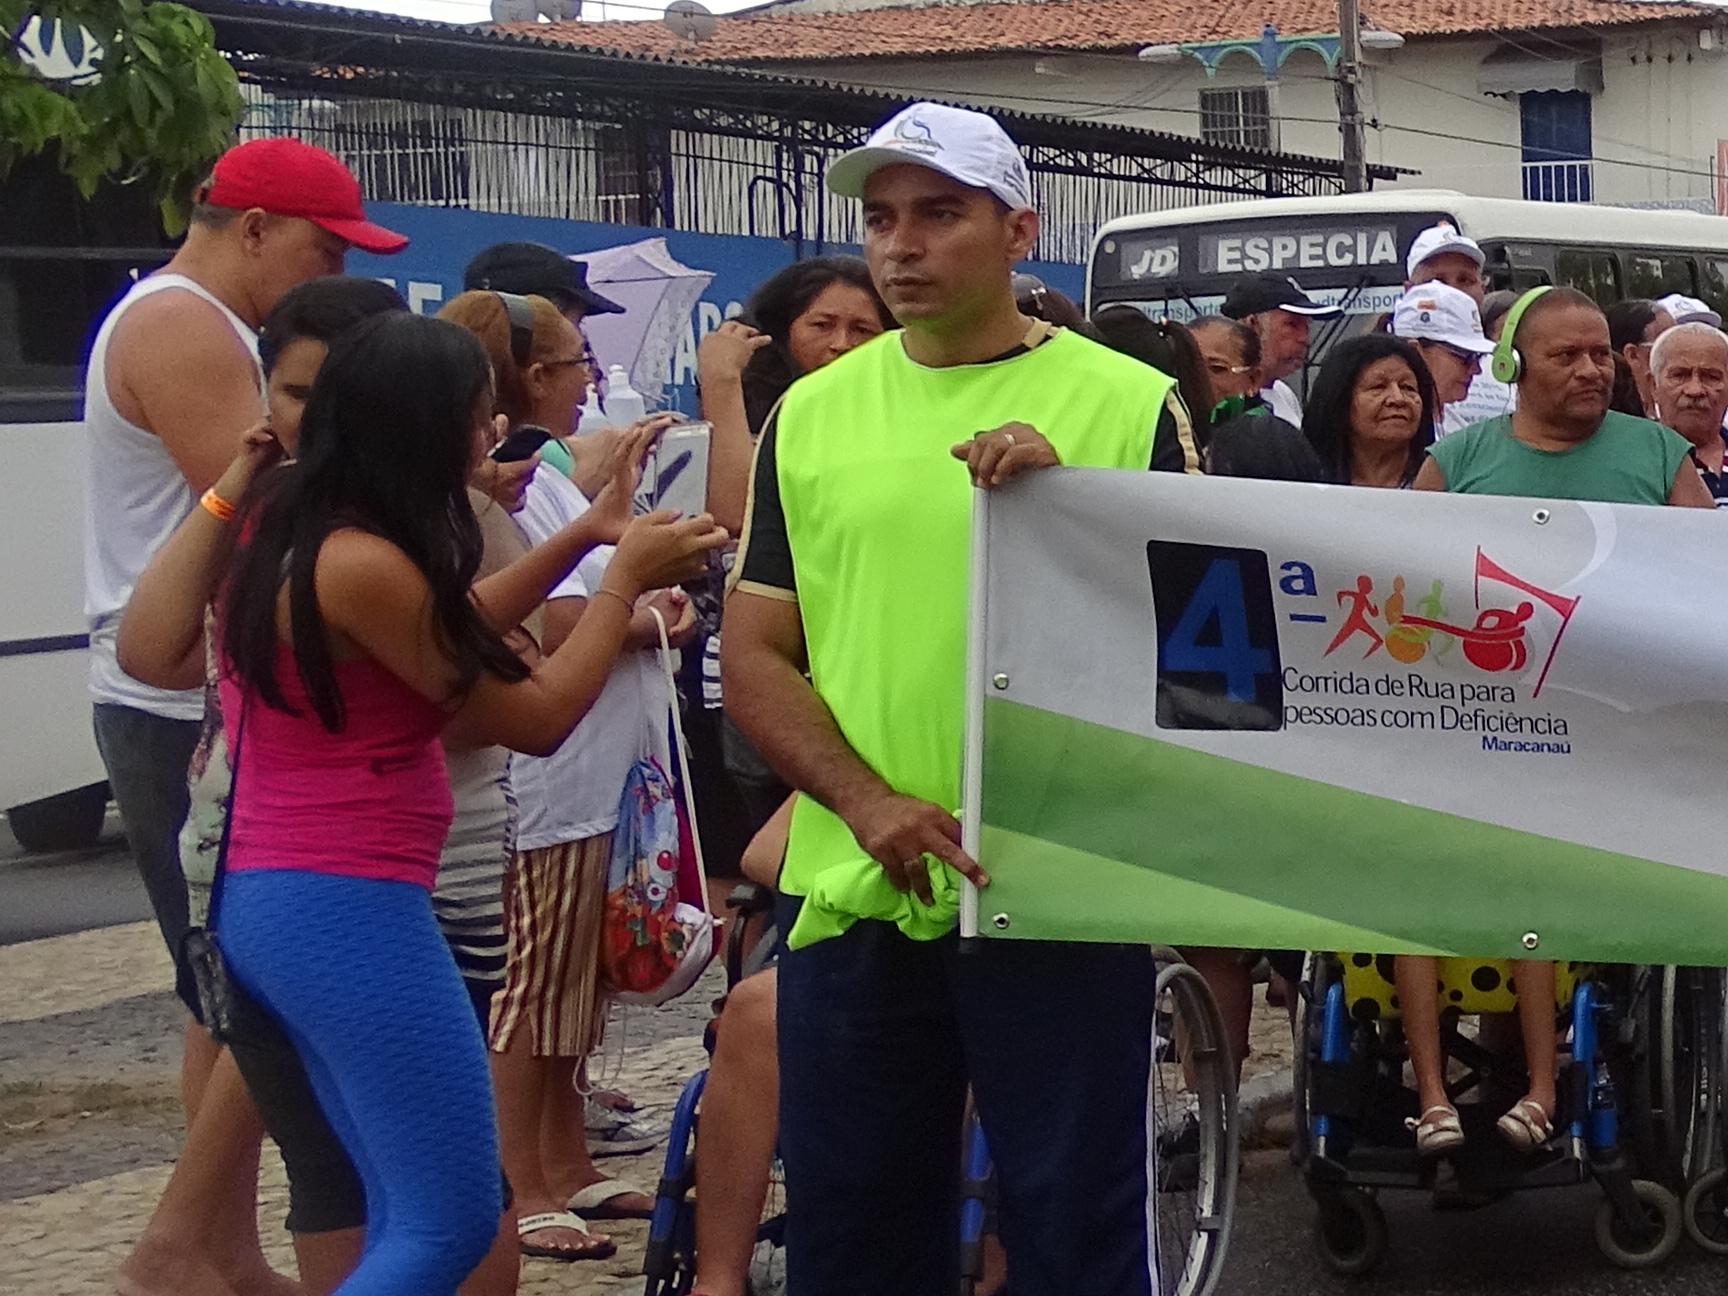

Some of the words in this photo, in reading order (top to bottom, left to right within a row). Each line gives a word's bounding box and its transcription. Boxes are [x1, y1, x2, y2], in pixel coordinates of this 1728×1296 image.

[1216, 230, 1398, 273] ESPECIA
[1282, 666, 1376, 698] Corrida
[1375, 671, 1405, 697] de
[1409, 673, 1457, 700] Rua
[1459, 680, 1516, 708] para
[1284, 703, 1378, 731] pessoas
[1380, 708, 1436, 730] com
[1439, 705, 1570, 737] Deficiência
[1481, 735, 1572, 755] Maracanaú
